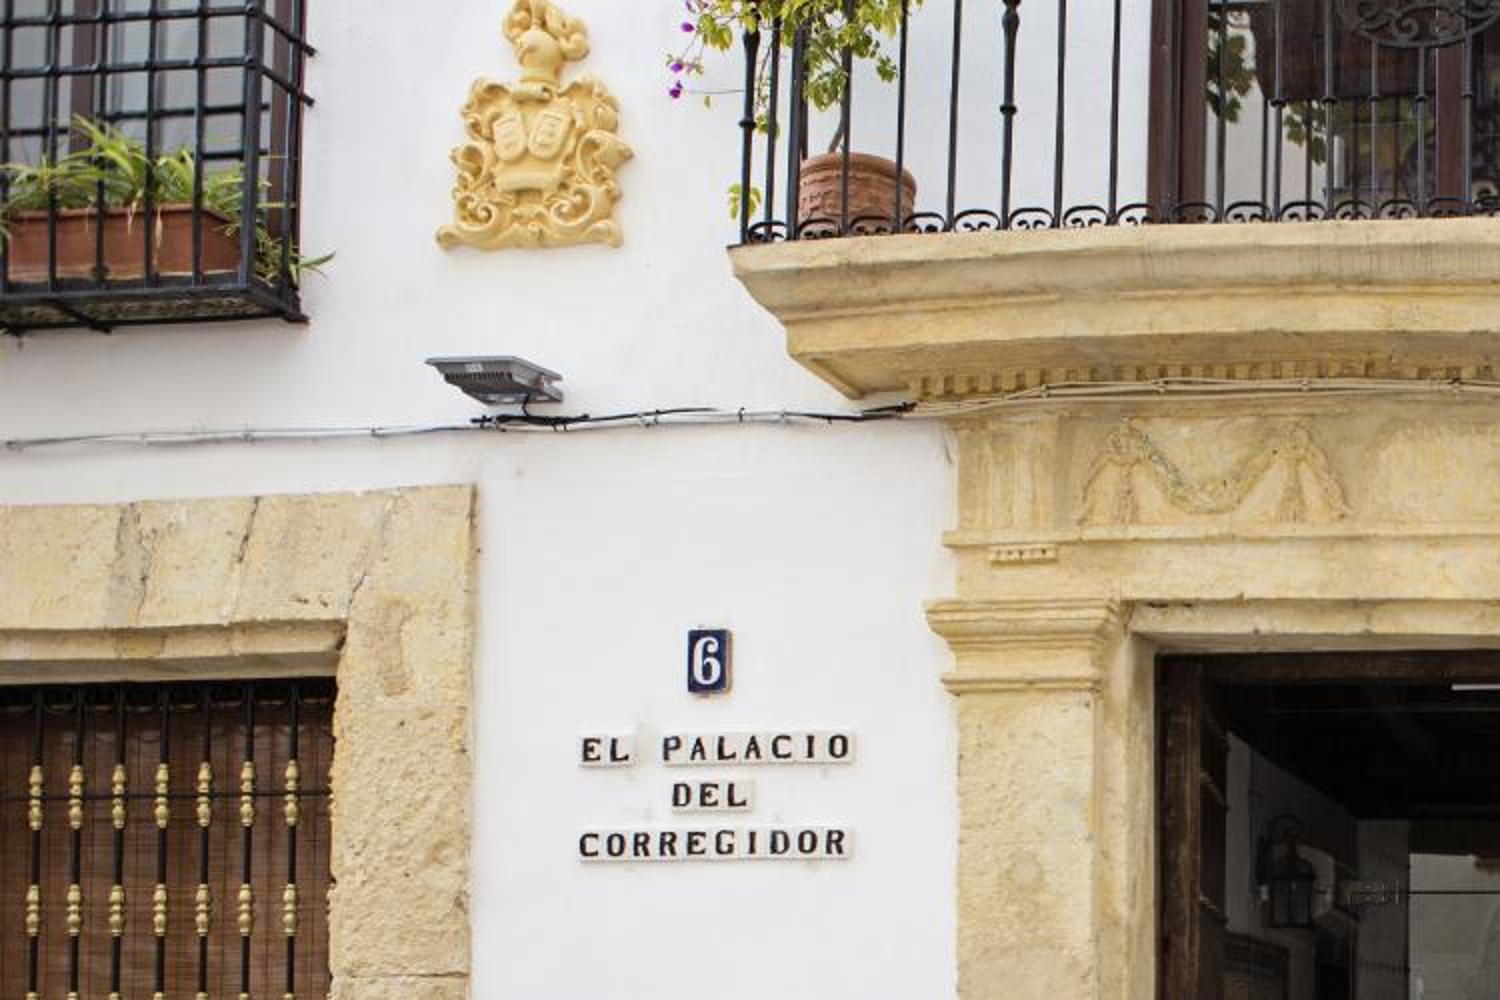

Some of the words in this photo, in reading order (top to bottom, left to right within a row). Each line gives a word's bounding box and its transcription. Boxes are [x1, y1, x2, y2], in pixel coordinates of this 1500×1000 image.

[693, 636, 721, 685] 6
[581, 737, 630, 763] EL
[662, 734, 849, 762] PALACIO
[672, 782, 748, 808] DEL
[579, 829, 846, 857] CORREGIDOR
